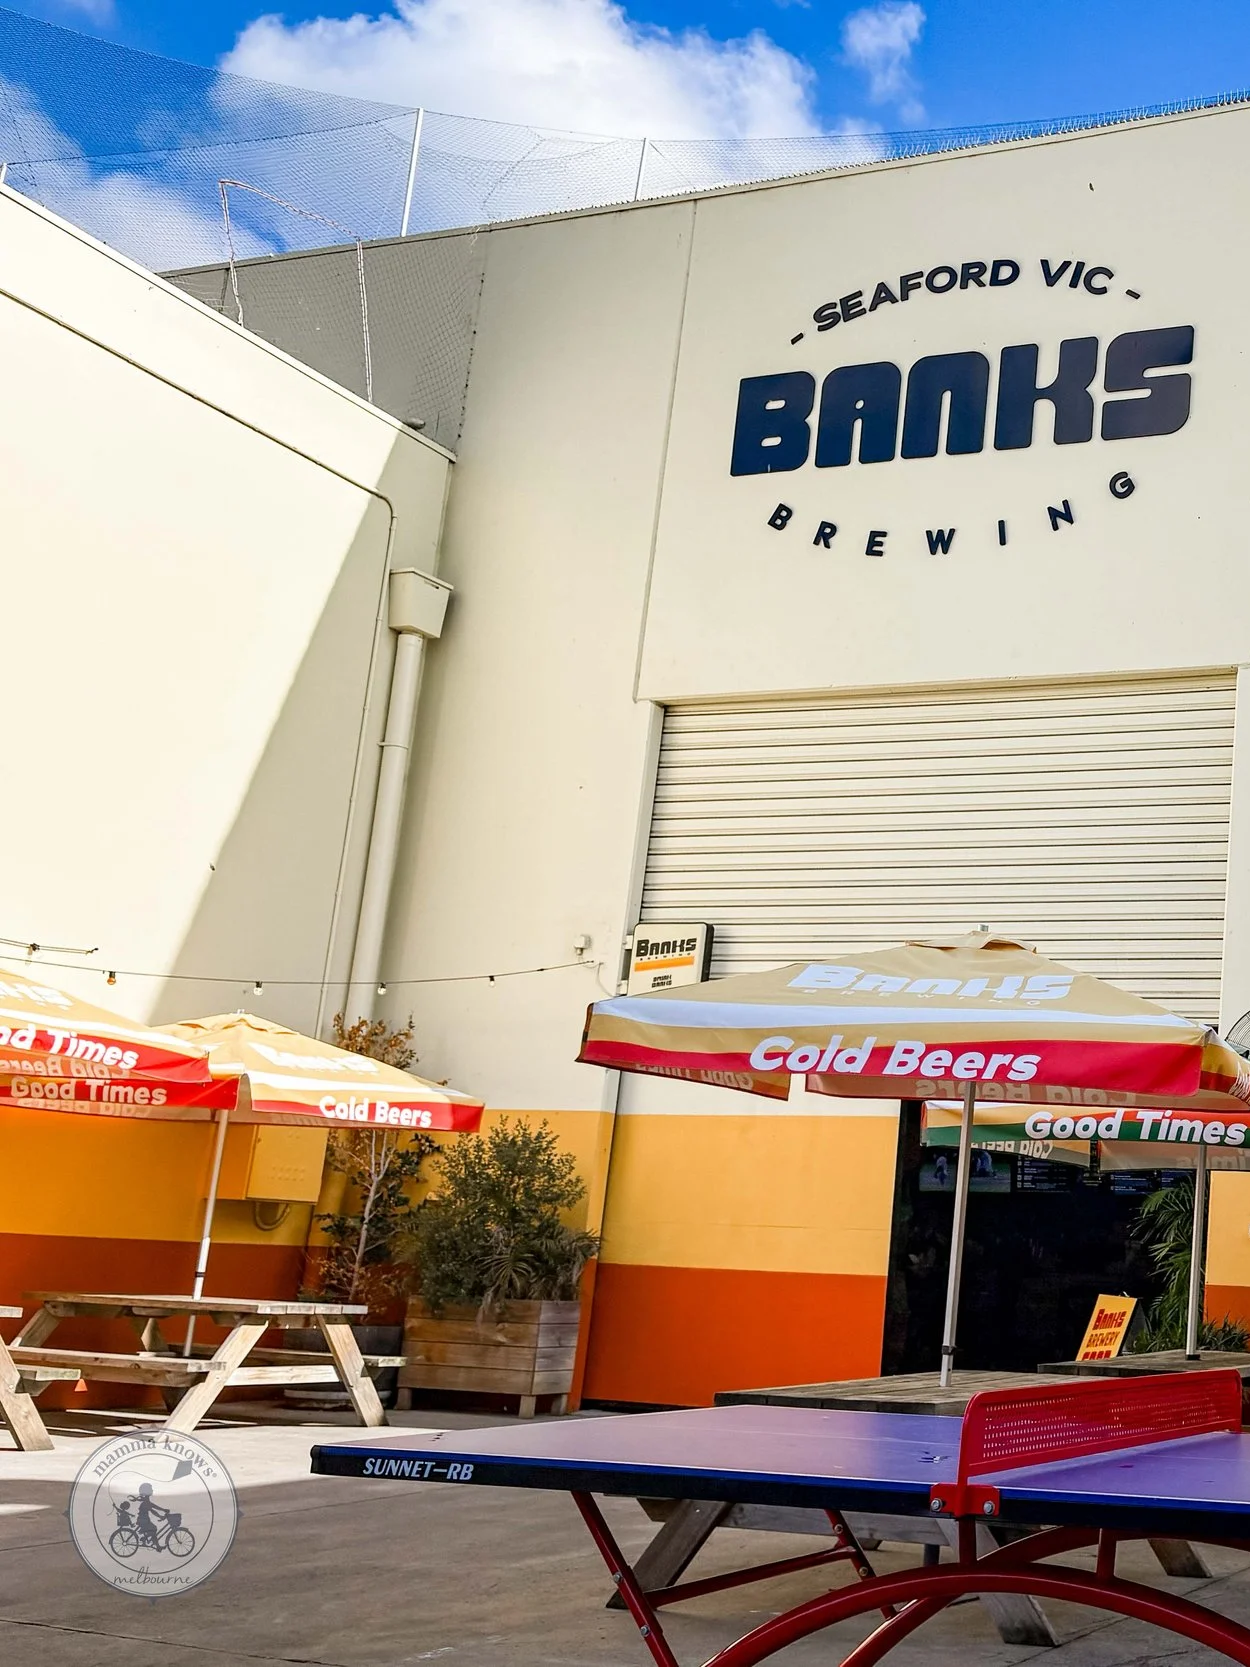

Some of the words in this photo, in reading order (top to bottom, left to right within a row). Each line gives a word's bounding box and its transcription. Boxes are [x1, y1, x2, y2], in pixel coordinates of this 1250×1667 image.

[813, 259, 1020, 332] SEAFORD
[1040, 259, 1114, 295] VIC
[730, 325, 1195, 476] BANKS
[767, 471, 1136, 557] BREWING
[636, 938, 697, 957] BANKS
[787, 964, 1074, 1000] BANKS
[46, 1030, 140, 1070] Times
[750, 1035, 877, 1075] Cold
[883, 1040, 1042, 1081] Beers
[11, 1075, 76, 1100] Good
[85, 1079, 167, 1106] Times
[319, 1095, 369, 1121] Cold
[375, 1100, 432, 1128] Beers
[1024, 1107, 1125, 1140] Good
[1136, 1110, 1248, 1145] Times
[1092, 1308, 1127, 1330] BANKS
[1086, 1331, 1120, 1348] BREWERY
[362, 1457, 475, 1481] SUNNET-RB
